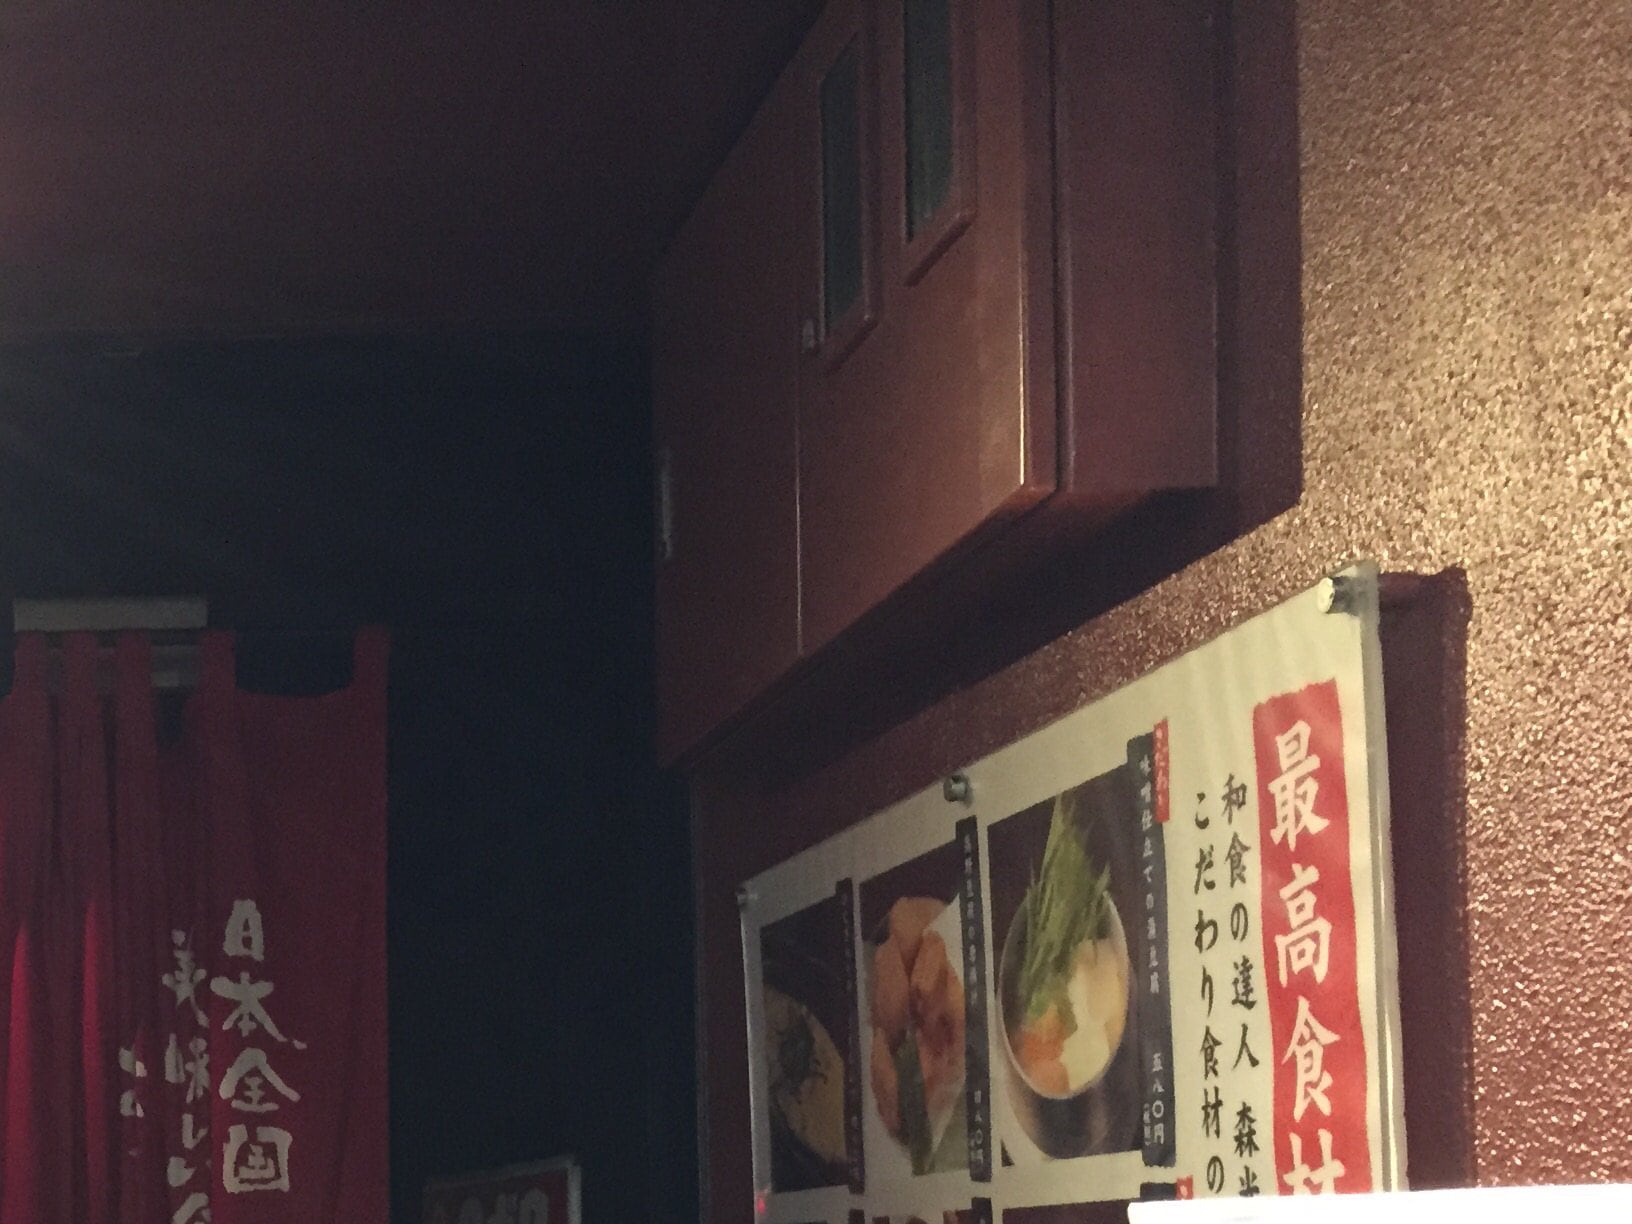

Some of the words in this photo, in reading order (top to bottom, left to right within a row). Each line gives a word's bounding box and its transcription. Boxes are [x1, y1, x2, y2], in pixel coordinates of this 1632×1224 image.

[209, 898, 307, 1194] 日本全国
[1193, 792, 1225, 1194] こだわり食材の
